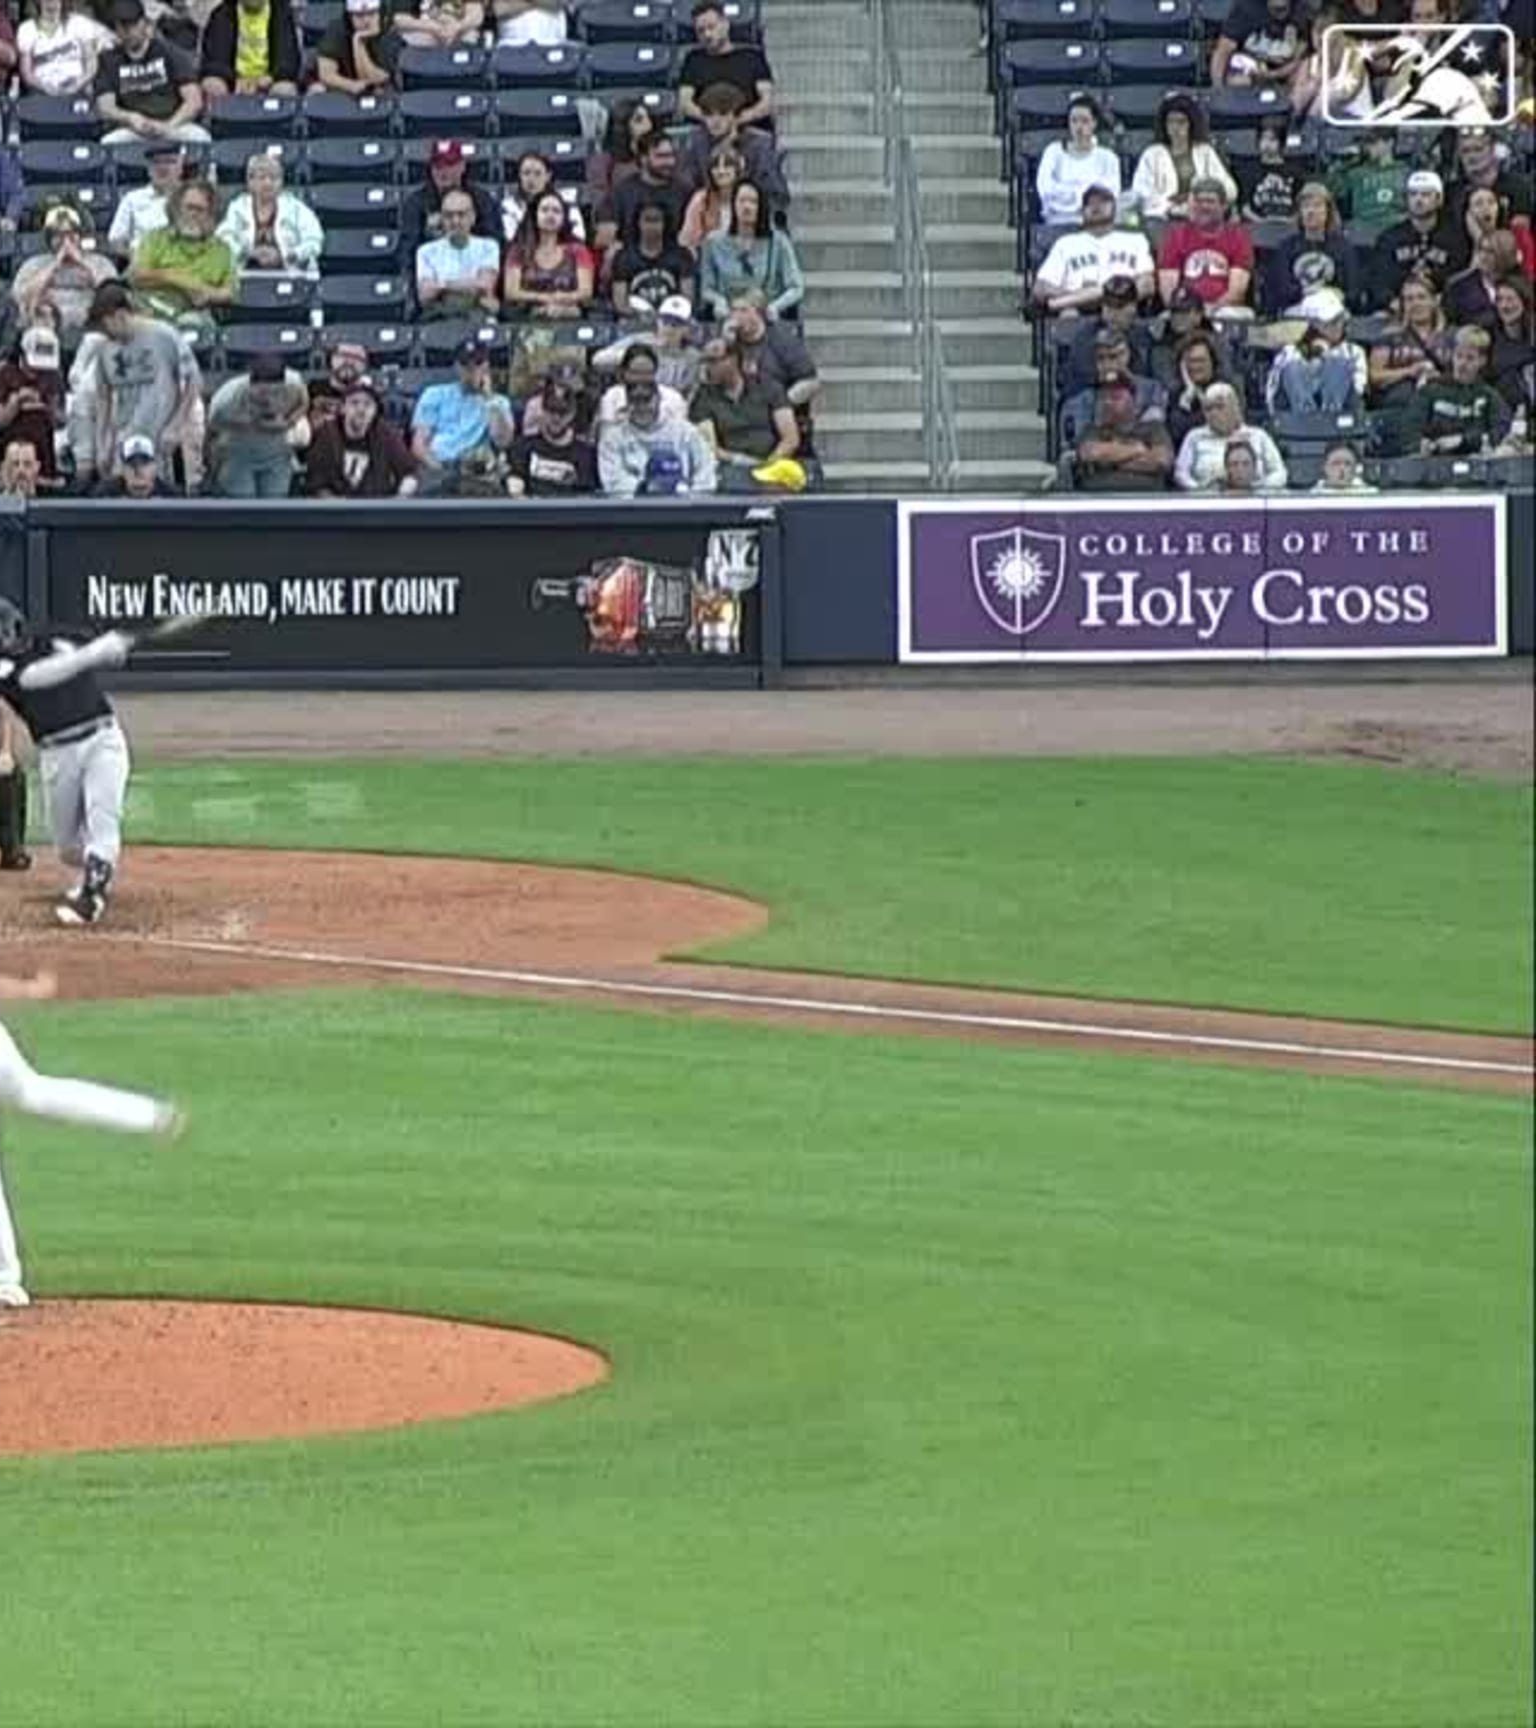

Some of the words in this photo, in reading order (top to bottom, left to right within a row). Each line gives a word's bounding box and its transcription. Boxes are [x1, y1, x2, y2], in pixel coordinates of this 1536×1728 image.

[1079, 531, 1262, 556] COLLEGE
[1282, 532, 1330, 554] OF
[1350, 530, 1430, 553] THE
[281, 578, 346, 616] MAKE
[352, 577, 377, 616] IT
[381, 577, 459, 616] COUNT
[1080, 570, 1233, 638] Holy
[1251, 569, 1430, 625] Cross
